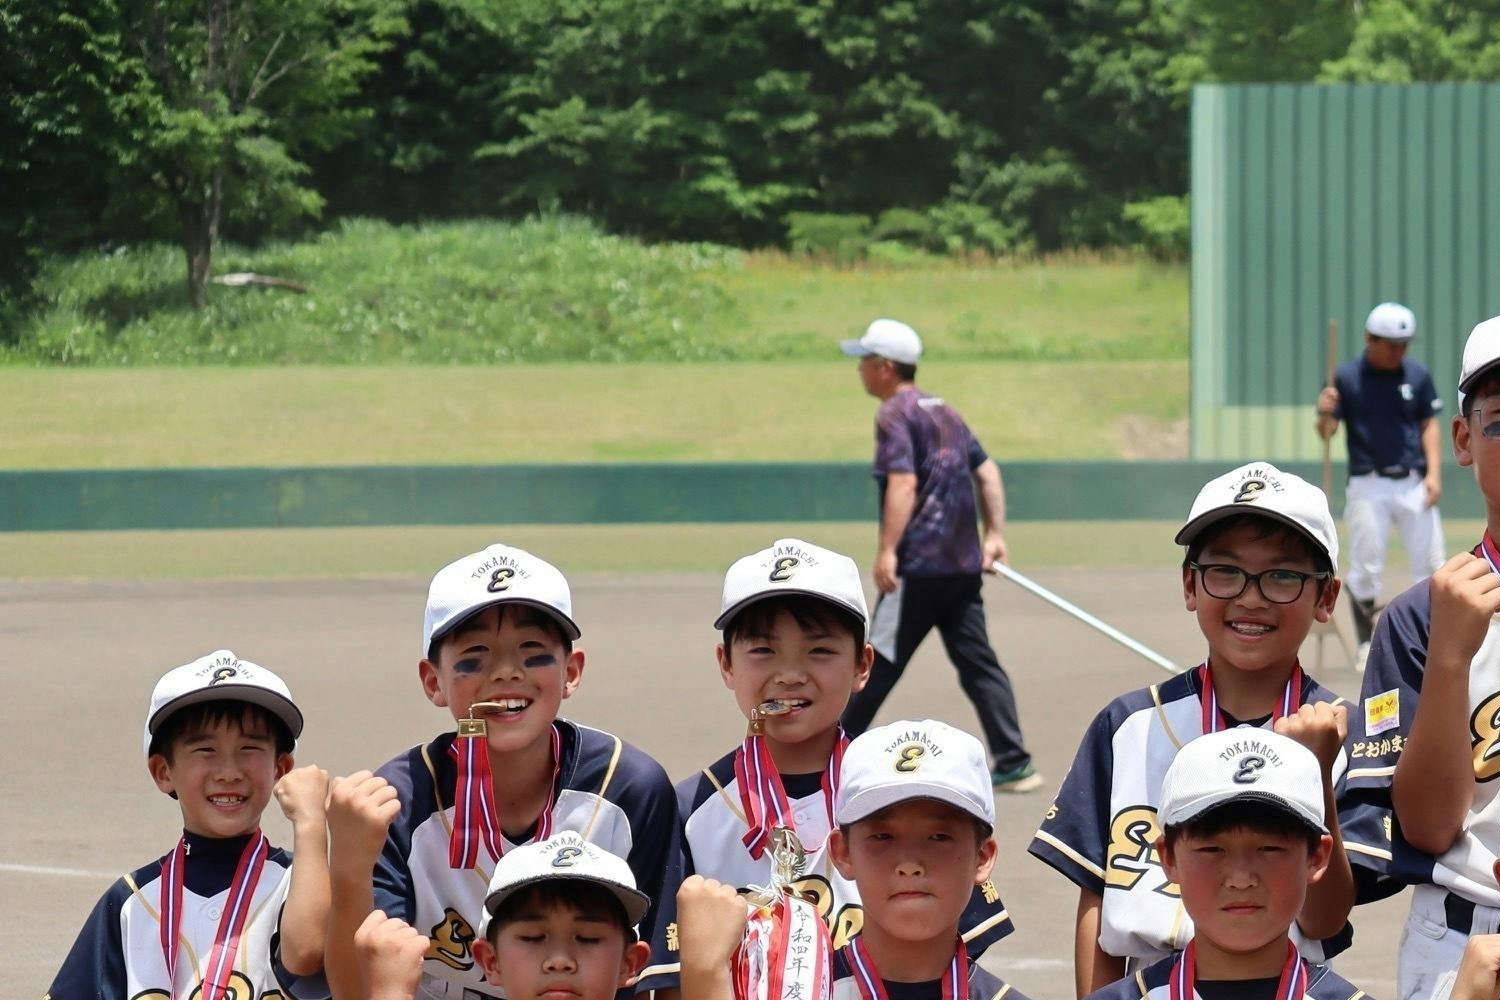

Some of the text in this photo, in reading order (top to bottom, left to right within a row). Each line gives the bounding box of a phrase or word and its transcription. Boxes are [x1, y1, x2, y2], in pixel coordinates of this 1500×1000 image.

[884, 730, 944, 758] TOKAMACHI
[1219, 740, 1284, 769] TOKAMACHI
[1351, 735, 1409, 758] とおかま
